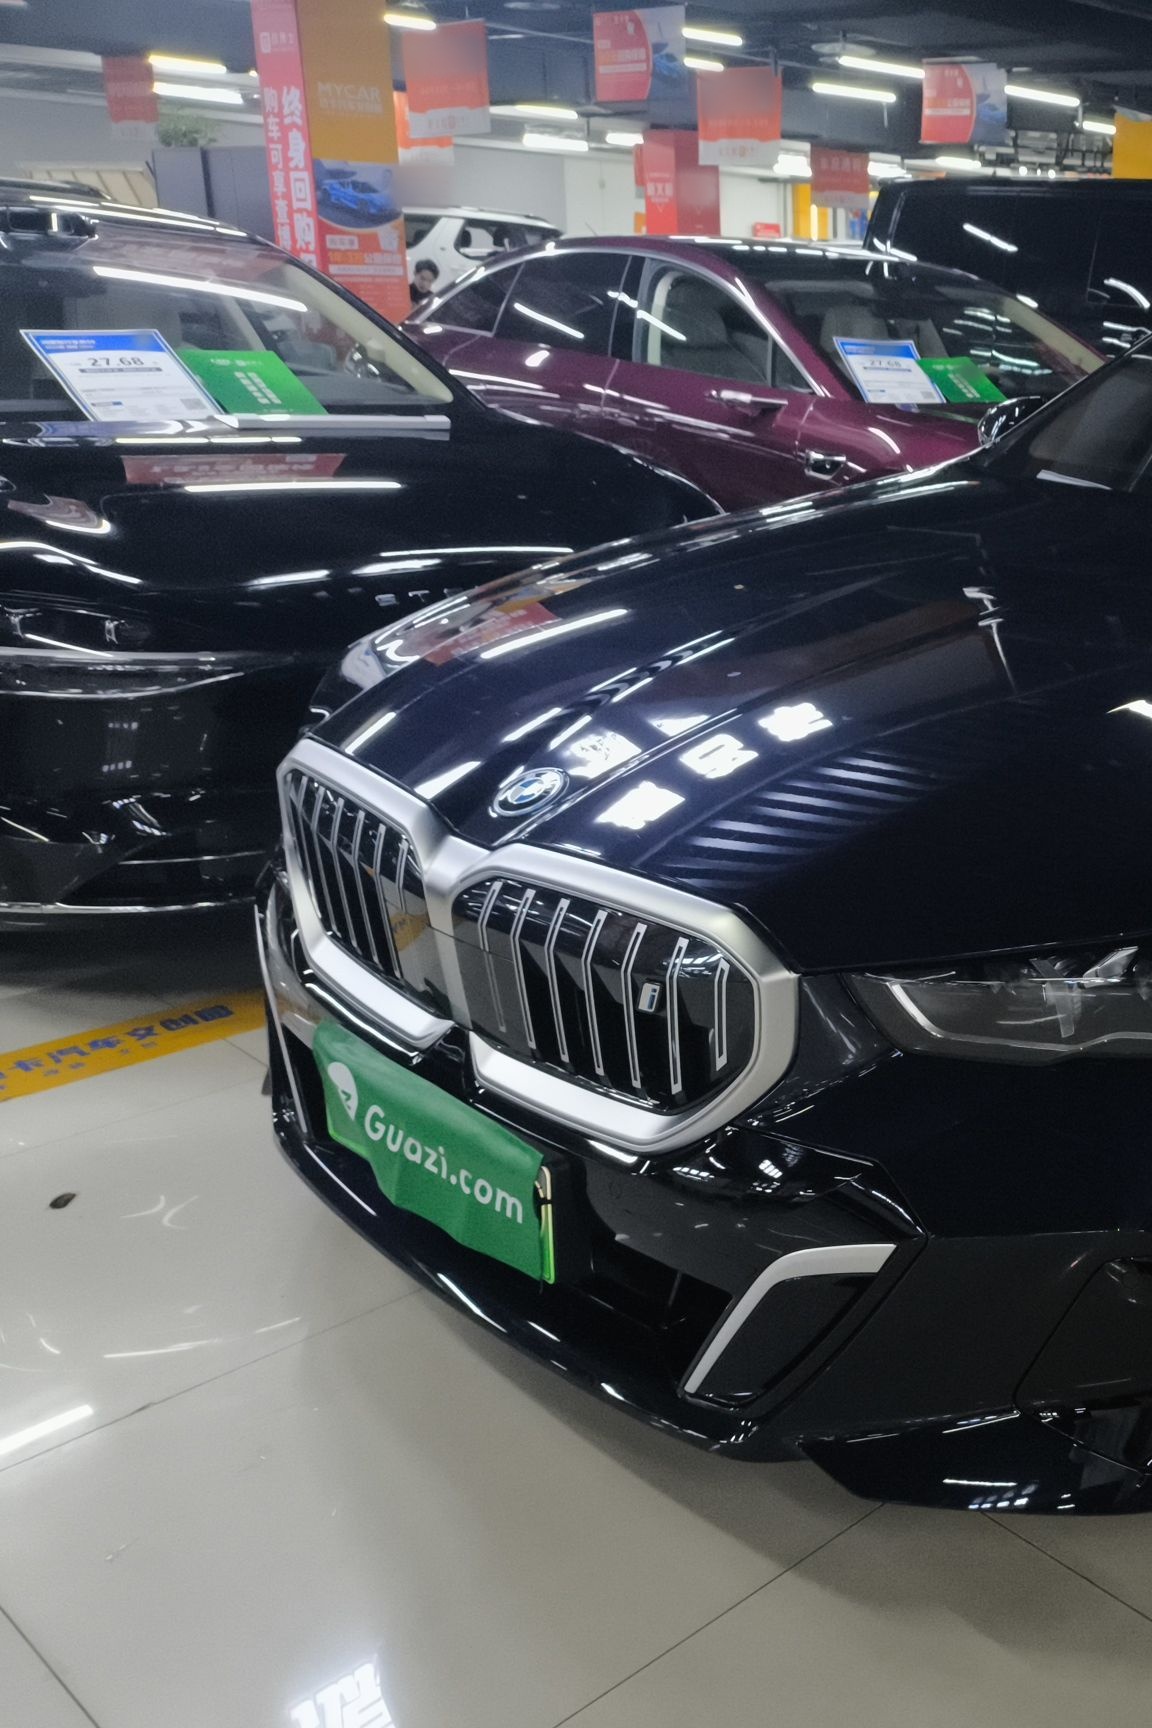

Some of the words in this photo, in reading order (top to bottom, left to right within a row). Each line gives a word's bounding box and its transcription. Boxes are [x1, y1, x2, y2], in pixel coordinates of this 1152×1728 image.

[318, 81, 381, 100] MYCAR
[88, 357, 145, 367] 27.68
[364, 1104, 524, 1224] Guazi.com
